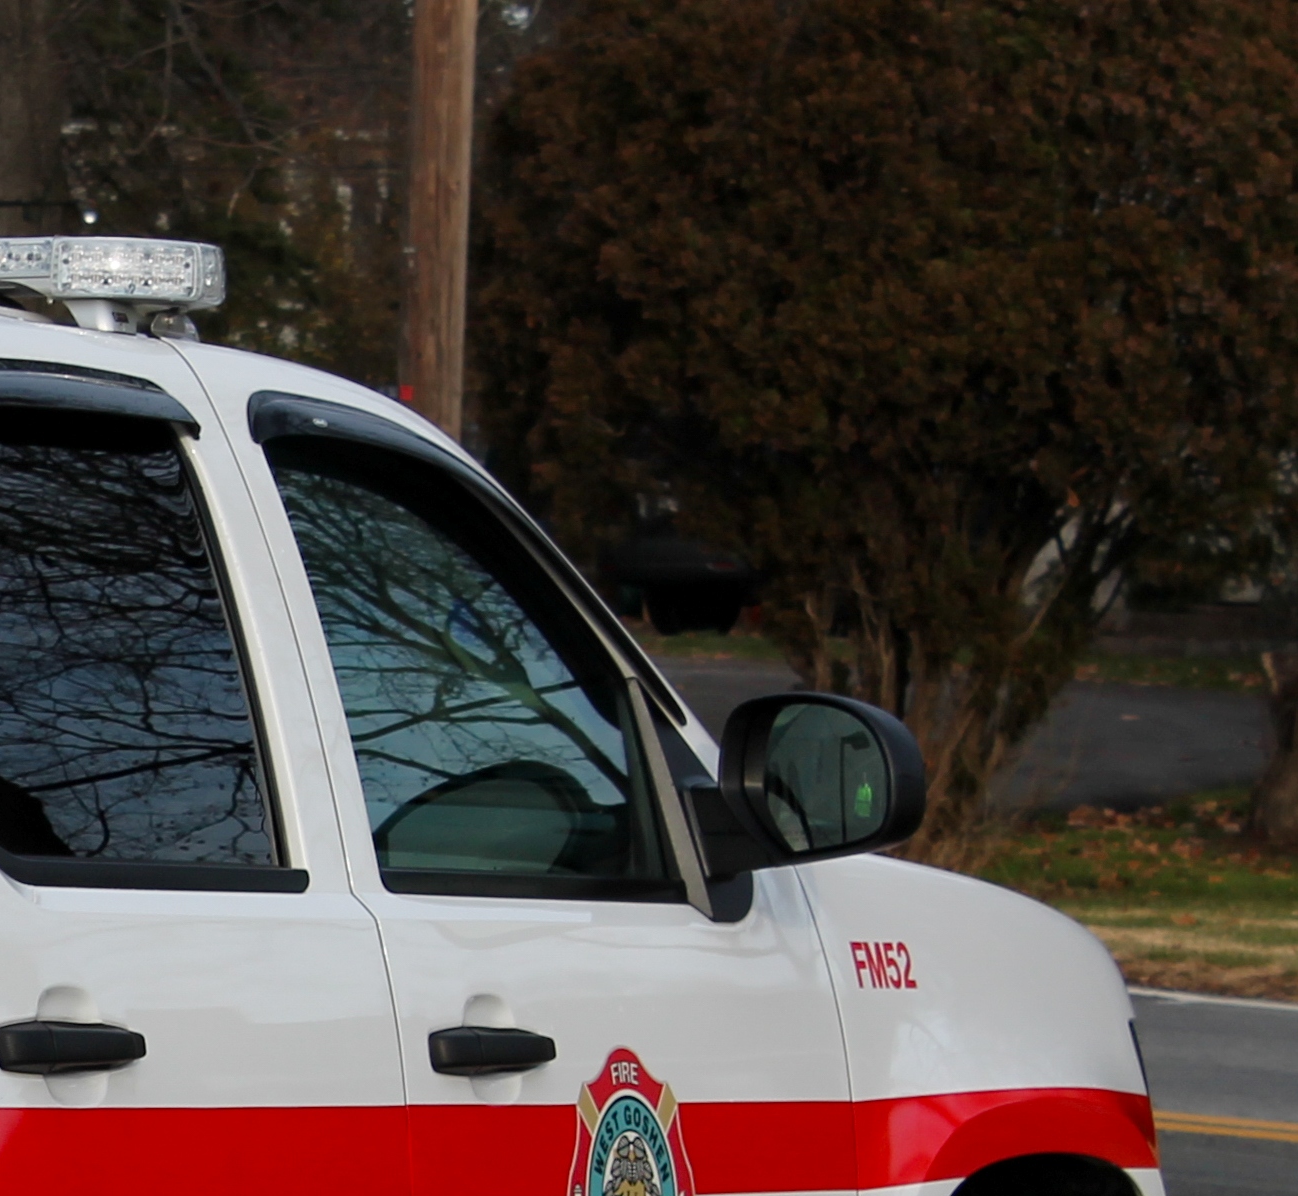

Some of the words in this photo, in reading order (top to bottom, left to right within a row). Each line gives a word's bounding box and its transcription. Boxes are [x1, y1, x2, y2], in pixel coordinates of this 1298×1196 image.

[848, 940, 918, 989] FM52
[610, 1061, 640, 1086] FIRE
[593, 1110, 619, 1177] WEST
[623, 1104, 671, 1183] GOSHEN
